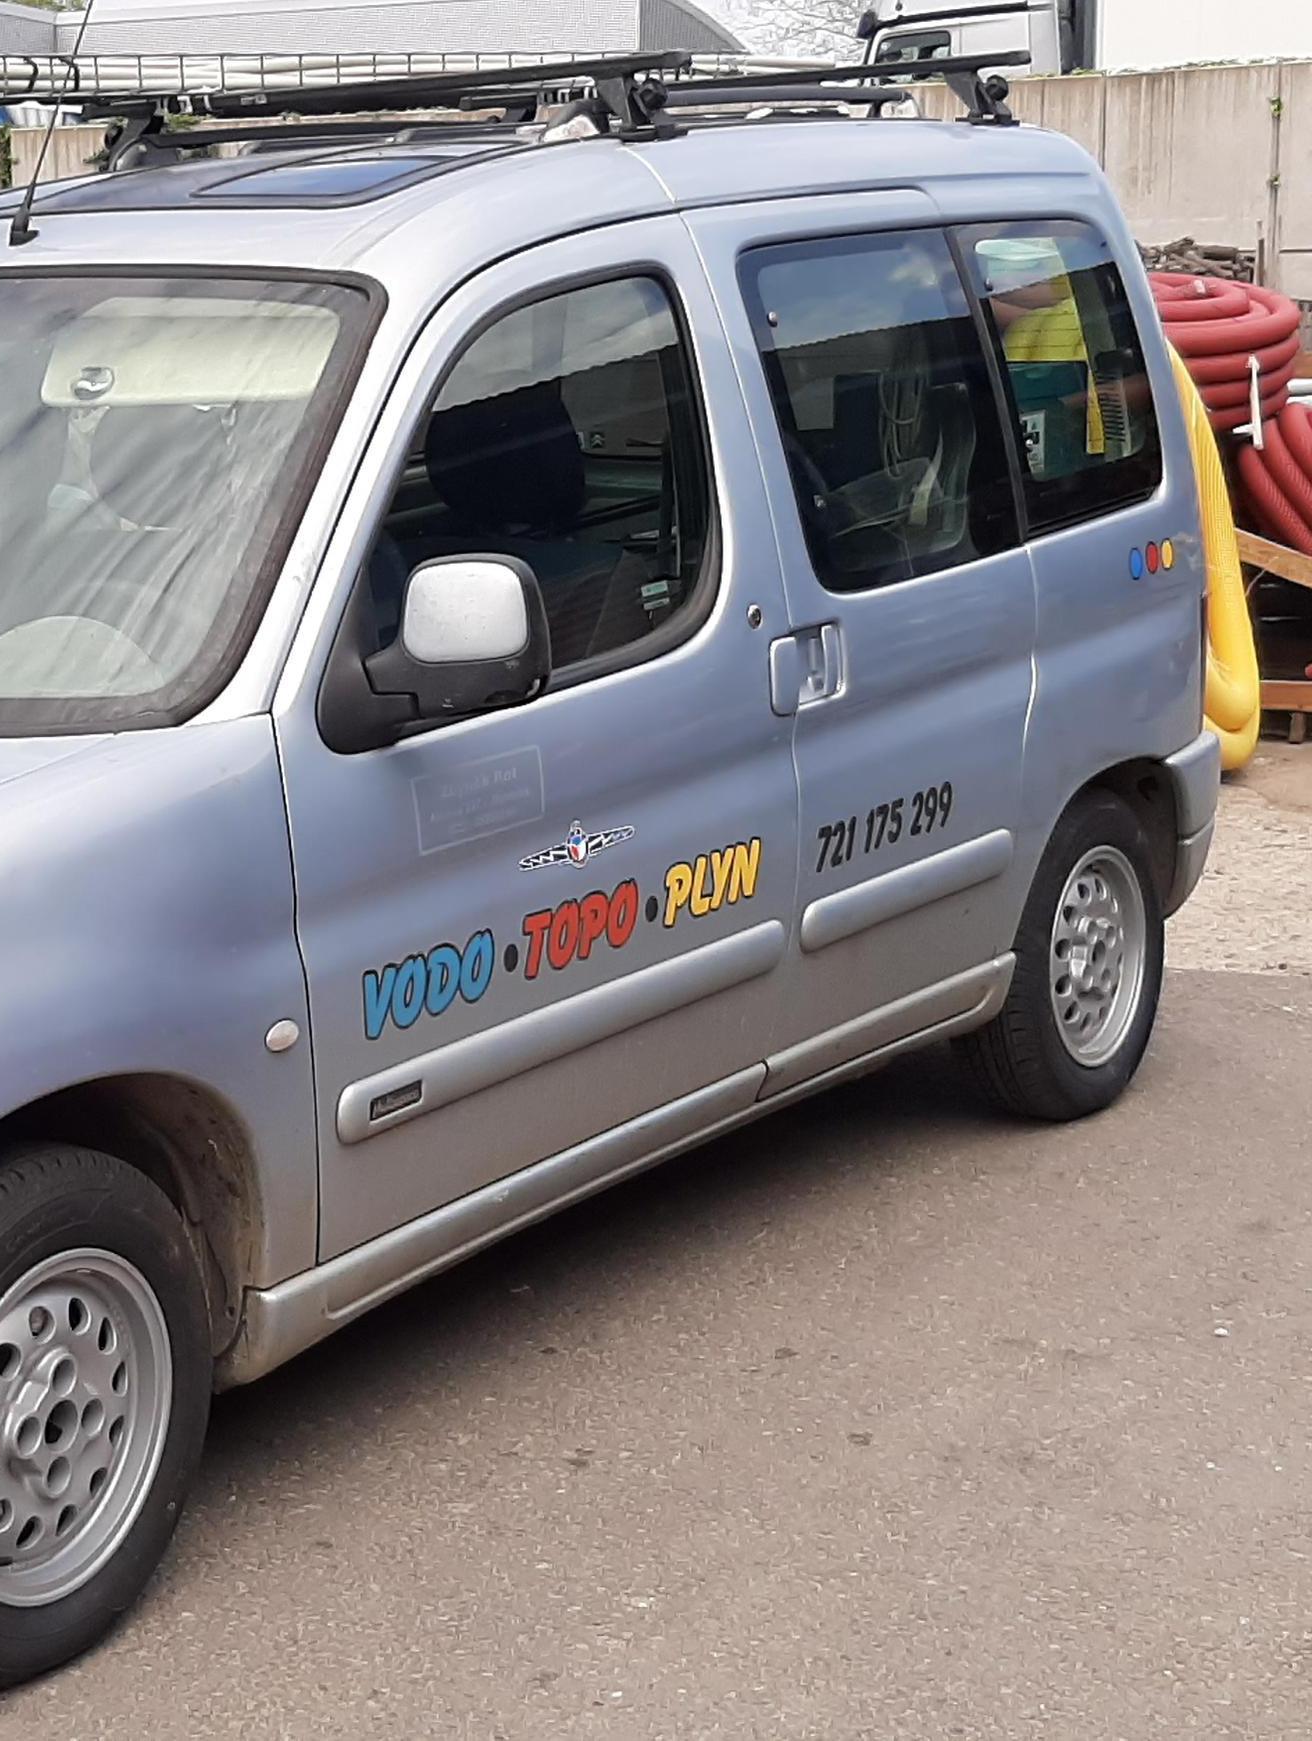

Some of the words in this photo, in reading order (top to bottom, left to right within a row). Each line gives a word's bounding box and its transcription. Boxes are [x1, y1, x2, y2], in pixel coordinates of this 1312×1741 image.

[816, 816, 857, 873] 721
[864, 798, 904, 853] 175
[910, 781, 953, 836] 299
[362, 929, 495, 1040] VODO
[523, 878, 639, 980] TOPO
[663, 836, 761, 928] PLYN
